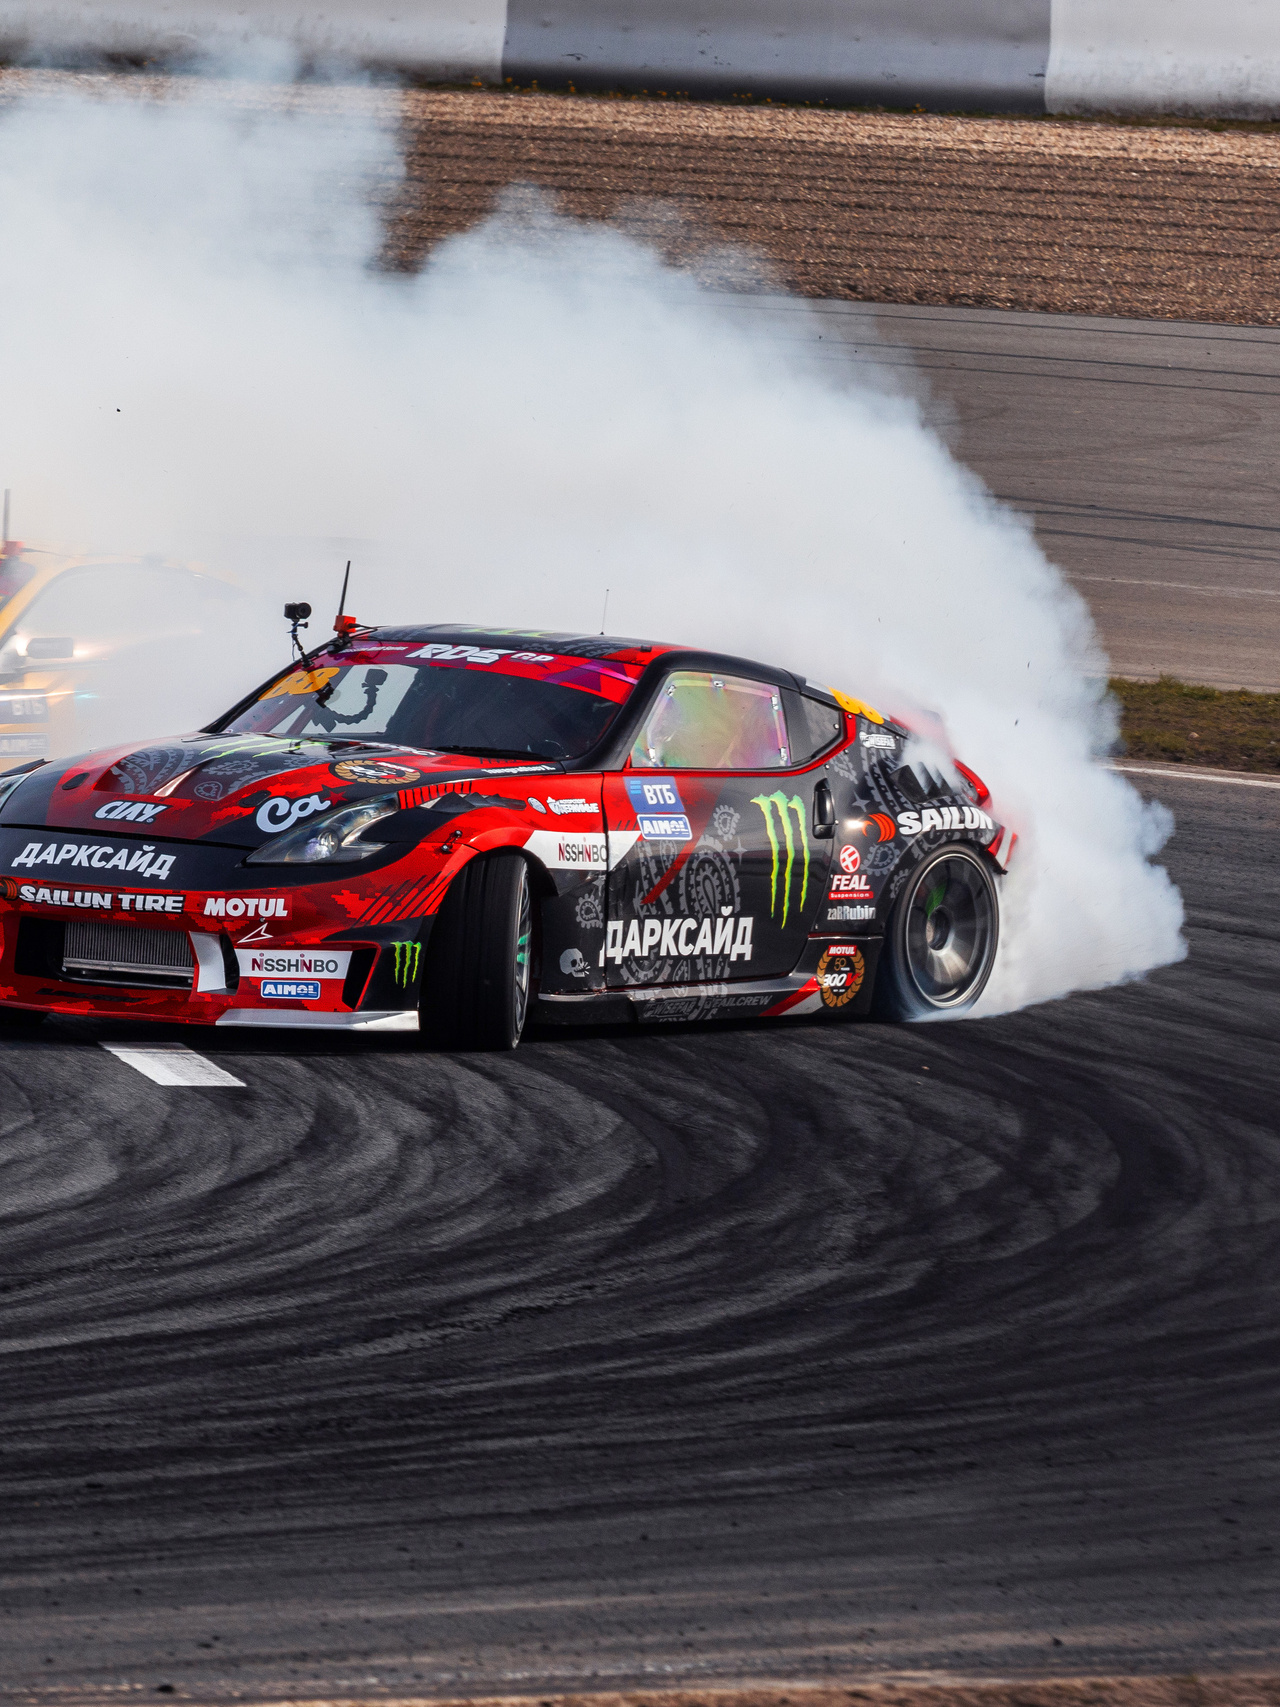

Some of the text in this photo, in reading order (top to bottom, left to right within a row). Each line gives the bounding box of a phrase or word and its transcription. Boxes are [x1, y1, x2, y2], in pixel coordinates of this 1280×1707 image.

[405, 643, 518, 664] RDS
[642, 784, 676, 805] ВТБ
[643, 820, 689, 835] AIMOL
[897, 806, 993, 835] SAILUN
[11, 843, 177, 880] ДАРКСАЙД
[831, 874, 871, 891] FEAL
[19, 885, 184, 913] SAILUN TIRE
[204, 898, 288, 917] MOTUL
[598, 906, 754, 967] ДАРКСАЙД
[829, 946, 856, 955] MOTUL
[264, 983, 318, 996] AIMOL
[823, 972, 861, 987] 300V
